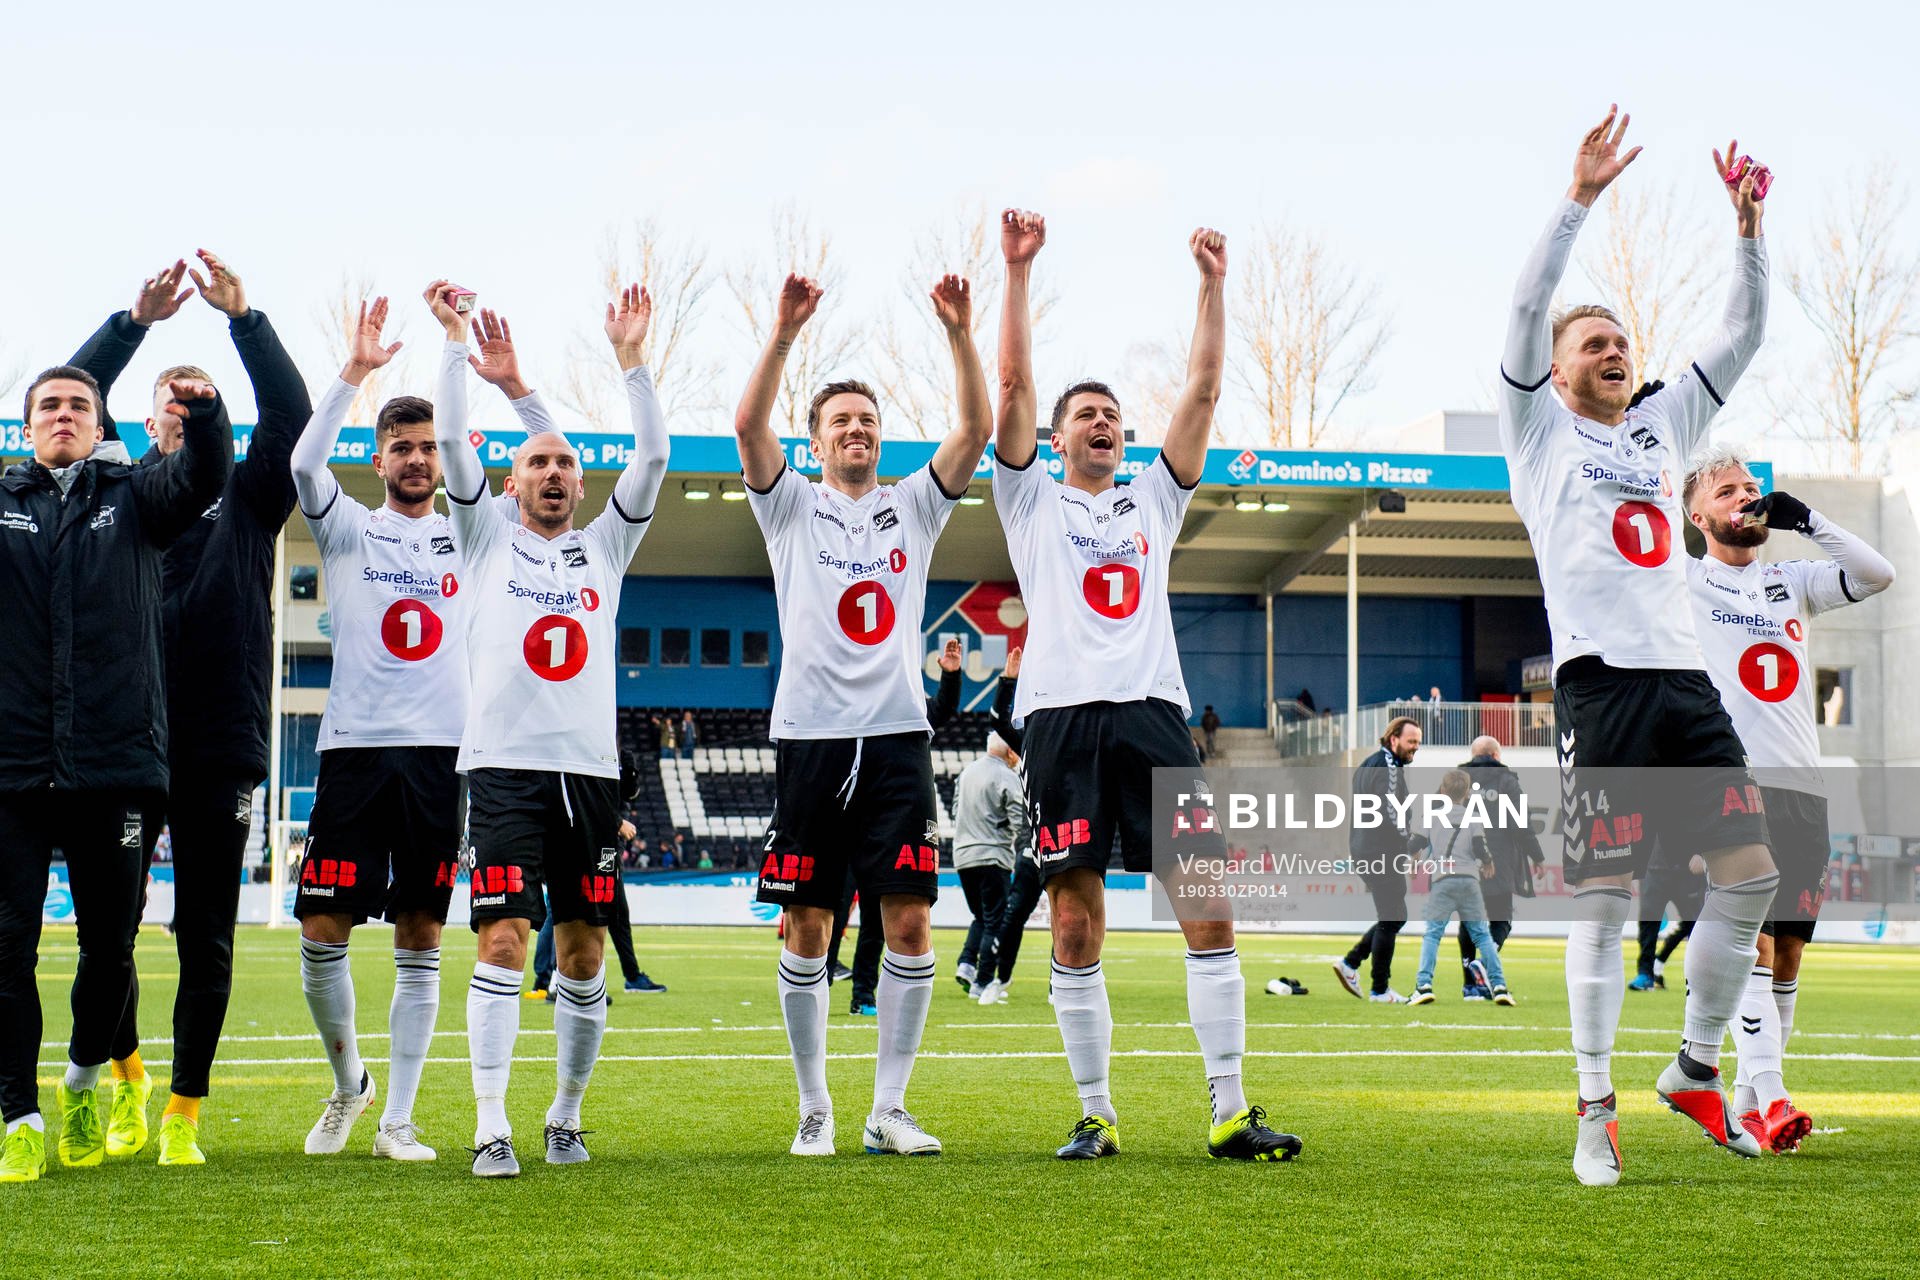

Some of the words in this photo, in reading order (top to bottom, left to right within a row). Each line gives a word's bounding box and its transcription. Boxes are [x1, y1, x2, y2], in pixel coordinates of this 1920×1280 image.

[1574, 425, 1613, 449] hummel
[1260, 459, 1362, 482] Domino's
[1368, 462, 1429, 484] Pizza
[851, 524, 865, 536] R8
[1096, 513, 1110, 525] R8
[364, 529, 401, 545] hummel
[1628, 513, 1655, 555] 1
[511, 542, 546, 566] hummel
[1091, 547, 1137, 559] TELEMARK
[393, 586, 440, 597] TELEMARK
[1103, 571, 1125, 607] 1
[1706, 578, 1740, 595] hummel
[856, 592, 877, 633] 1
[400, 610, 422, 649] 1
[544, 626, 567, 669] 1
[1757, 653, 1778, 691] 1
[1581, 790, 1610, 817] 14
[1040, 818, 1091, 852] ABB
[1589, 813, 1643, 849] ABB
[1594, 845, 1631, 860] hummel
[301, 859, 357, 887] ABB
[472, 865, 524, 896] ABB
[760, 853, 815, 881] ABB
[302, 885, 335, 897] hummel
[581, 873, 615, 903] ABB
[761, 878, 795, 892] hummel
